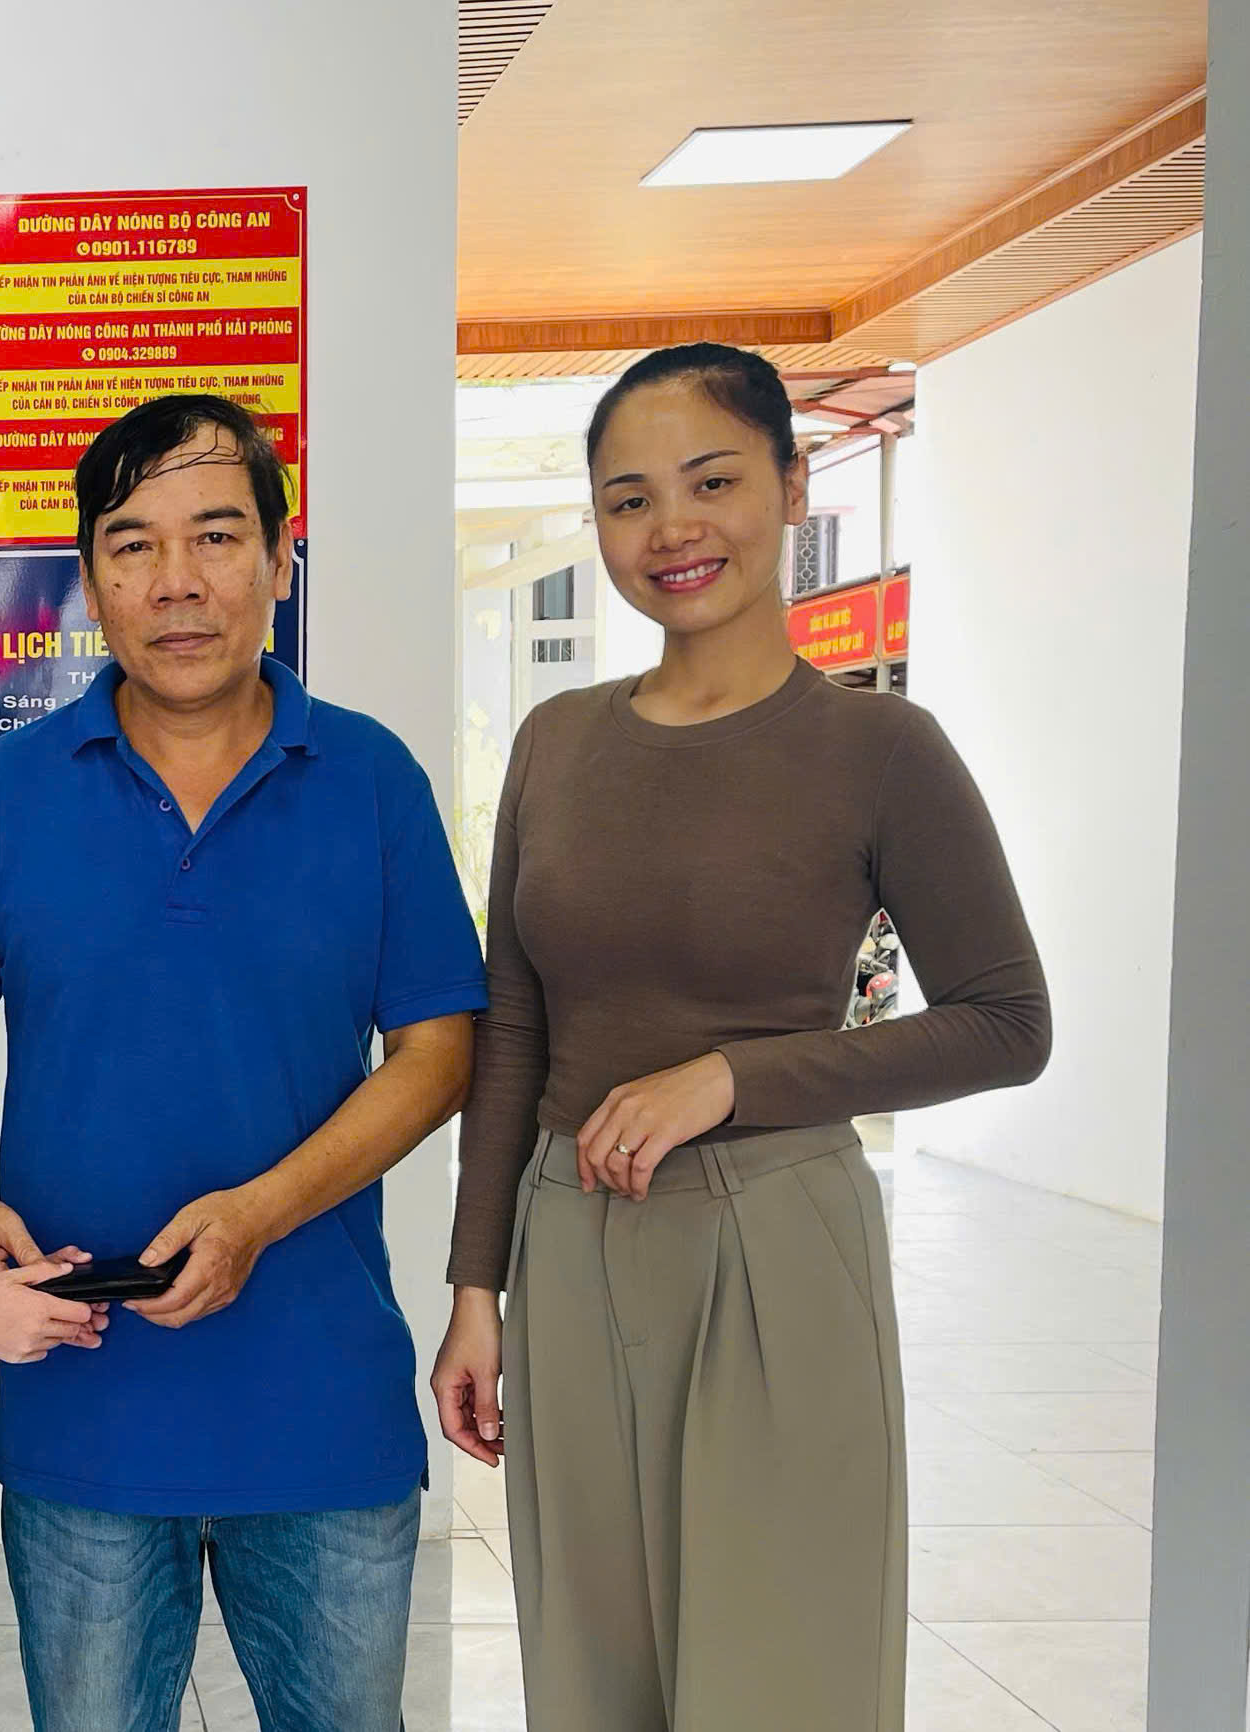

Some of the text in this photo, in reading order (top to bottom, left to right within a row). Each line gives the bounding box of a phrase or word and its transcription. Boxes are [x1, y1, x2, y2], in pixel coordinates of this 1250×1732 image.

[18, 210, 270, 233] ĐƯỜNG DÂY NÓNG BỘ CÔNG AN
[92, 239, 197, 256] 0901.116789
[14, 275, 39, 289] NHẬN
[42, 277, 56, 287] TIN
[109, 272, 119, 285] VỀ
[123, 273, 144, 287] HIỆN
[147, 273, 177, 286] TƯỢNG
[180, 271, 199, 283] TIÊU
[203, 272, 223, 285] CỰC,
[227, 272, 252, 282] THAM
[255, 270, 286, 282] NHŨNG
[68, 291, 86, 305] CỦA
[90, 291, 108, 304] CÁN
[111, 290, 123, 306] BỘ
[126, 289, 153, 304] CHIẾN
[169, 289, 193, 302] CÔNG
[197, 291, 209, 302] AN
[29, 323, 53, 339] DÂY
[57, 323, 91, 339] NÓNG
[95, 323, 129, 338] CÔNG
[132, 324, 150, 337] AN
[154, 320, 193, 337] THÀNH
[197, 318, 222, 336] PHỐ
[226, 318, 246, 335] HẢI
[250, 318, 292, 335] PHÒNG
[99, 346, 177, 361] 0904.329889
[12, 380, 37, 393] NHẬN
[41, 380, 54, 391] TIN
[107, 376, 118, 389] VỀ
[121, 376, 141, 391] HIỆN
[145, 378, 174, 390] TƯỢNG
[177, 375, 196, 388] TIÊU
[200, 376, 220, 389] CỰC,
[224, 376, 249, 387] THAM
[252, 373, 283, 386] NHŨNG
[13, 396, 30, 410] CỦA
[34, 396, 52, 409] CÁN
[73, 395, 99, 409] CHIẾN
[115, 394, 140, 408] CÔNG
[40, 431, 64, 447] DÂY
[13, 481, 38, 494] NHẬN
[41, 481, 55, 491] TIN
[20, 496, 38, 510] CỦA
[41, 497, 59, 509] CÁN
[3, 625, 109, 664] LỊCH TIẾ
[3, 695, 56, 710] Sáng
